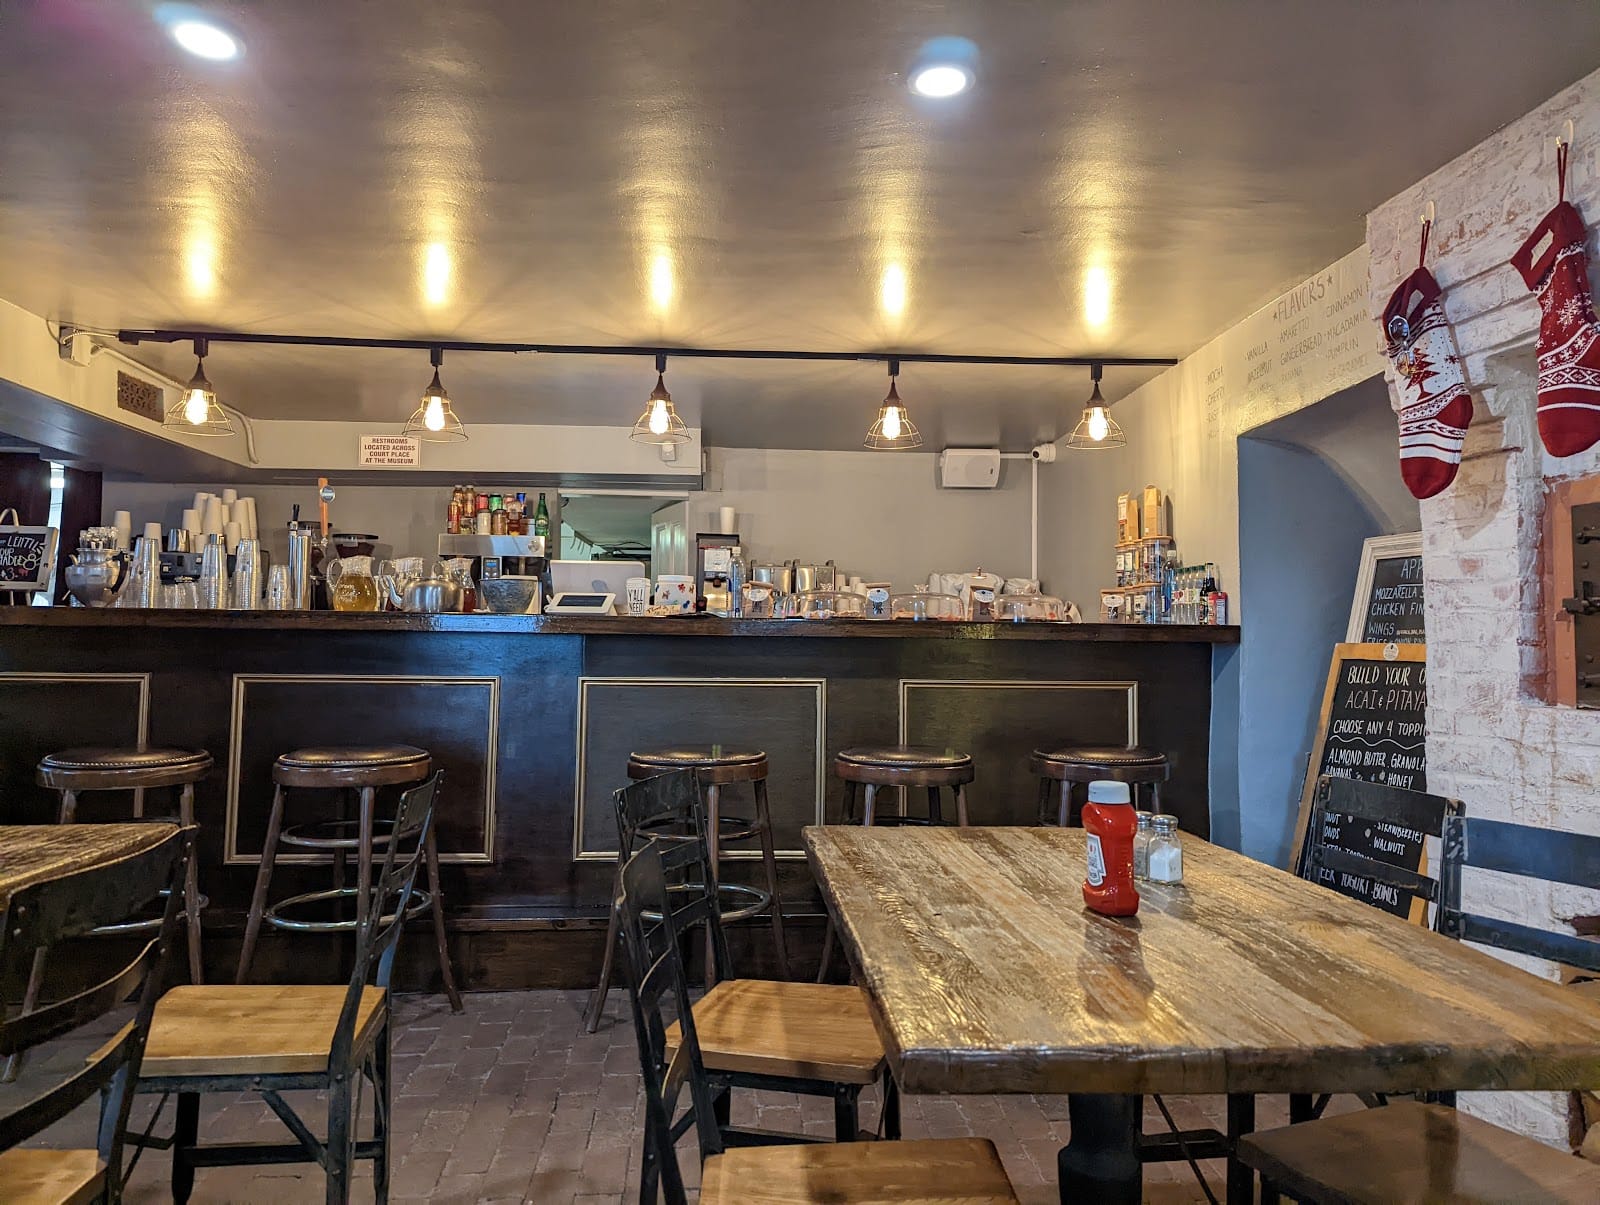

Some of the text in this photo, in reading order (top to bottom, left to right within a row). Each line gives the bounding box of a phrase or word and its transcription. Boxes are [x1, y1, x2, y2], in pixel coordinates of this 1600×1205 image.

[1277, 275, 1325, 321] FLAVORS
[1325, 284, 1363, 318] CINNAMON
[1326, 307, 1368, 341] MACADAMIA
[1374, 586, 1417, 600] MOZZARELLA
[1371, 602, 1405, 617] CHICKEN
[1368, 621, 1395, 636] WINGS
[1347, 665, 1380, 686] BUILD
[1385, 666, 1411, 687] YOUR
[1345, 689, 1379, 710] ACAI
[1386, 689, 1428, 712] PITAYA
[1333, 719, 1365, 735] CHOOSE
[1365, 720, 1384, 735] ANY
[1386, 719, 1394, 737] 4
[1327, 748, 1426, 772] ALMOND BUTTER GRANOLA
[1387, 772, 1414, 791] HONEY
[1373, 836, 1406, 856] WALNUTS
